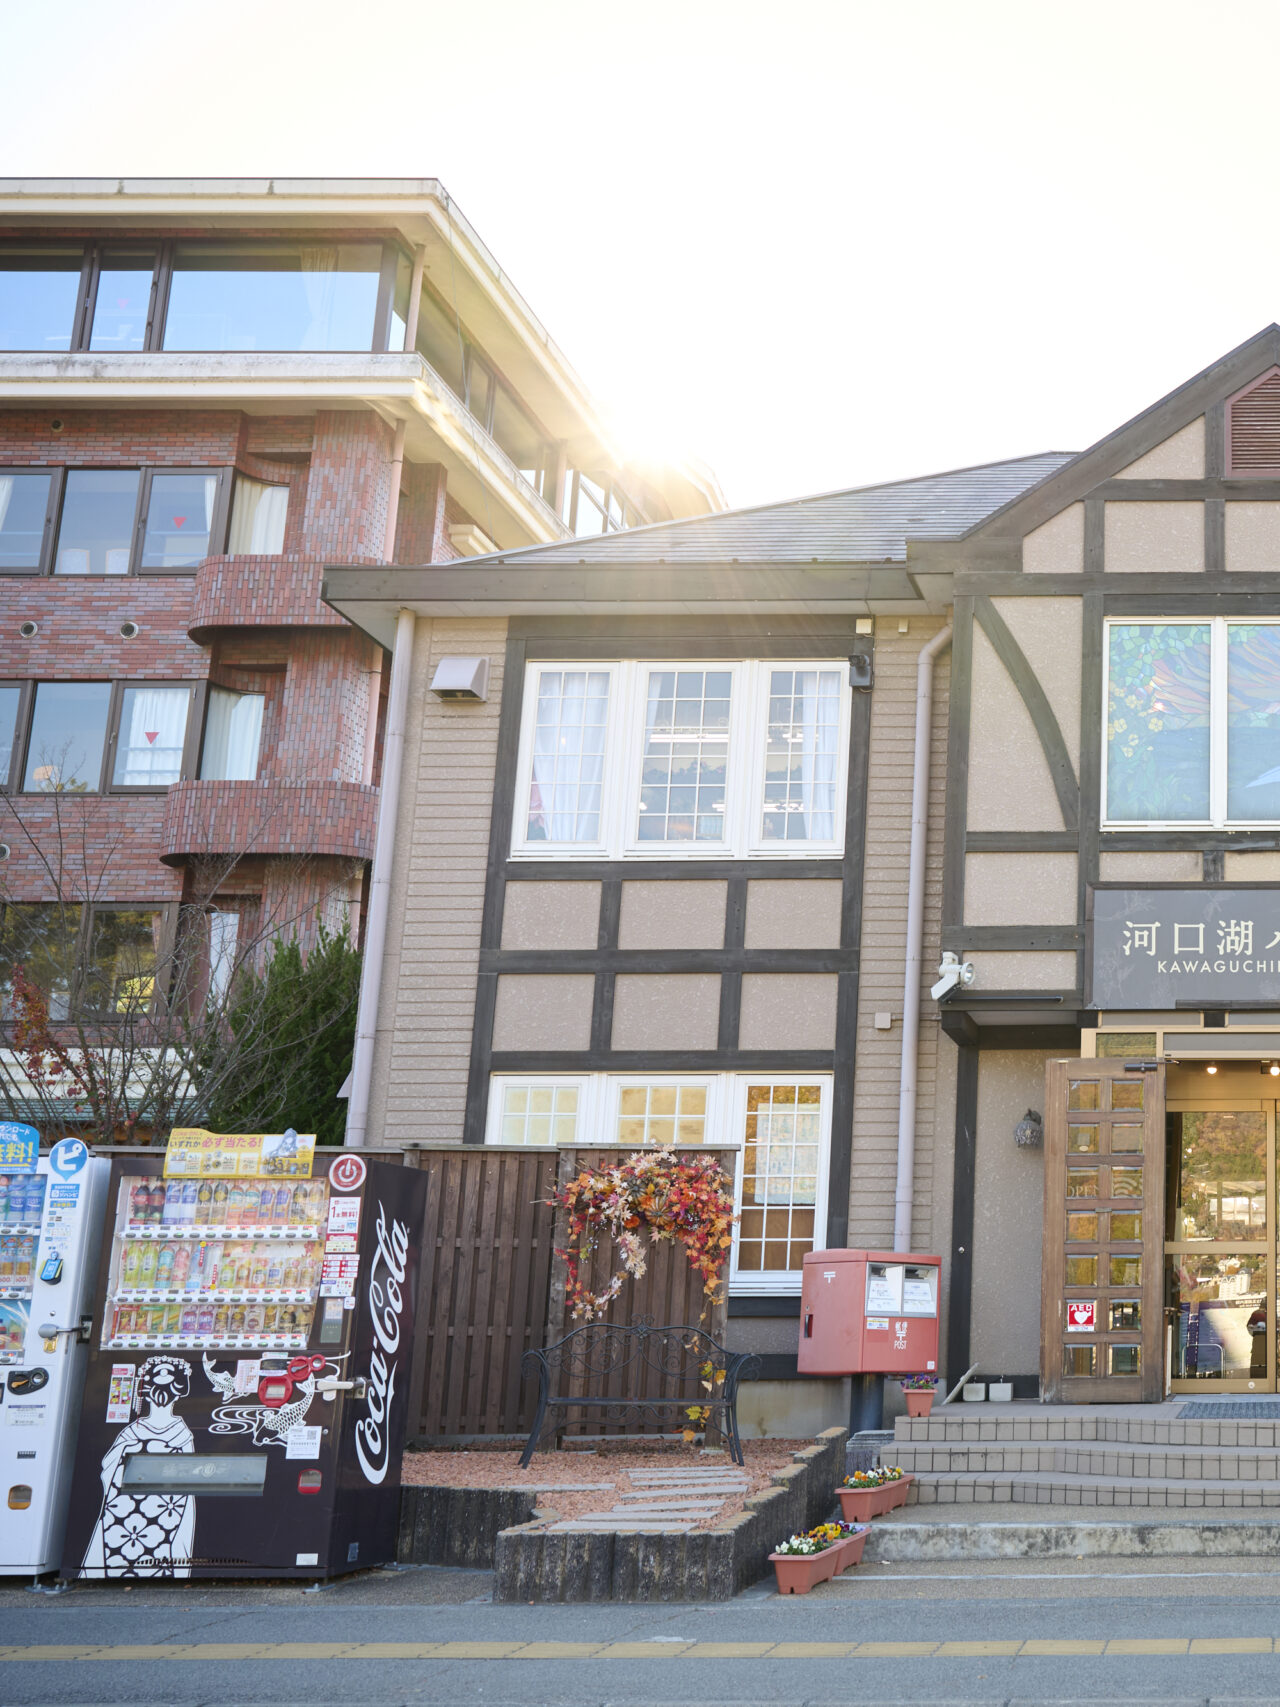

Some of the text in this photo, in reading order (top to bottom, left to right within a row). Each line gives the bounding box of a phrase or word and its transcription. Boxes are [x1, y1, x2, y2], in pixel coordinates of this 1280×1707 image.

[201, 1137, 262, 1148] 必ず当たる!
[0, 1141, 34, 1163] 料!
[1070, 1304, 1093, 1312] AED
[355, 1199, 409, 1485] Coca-Cola
[894, 1340, 907, 1350] POST
